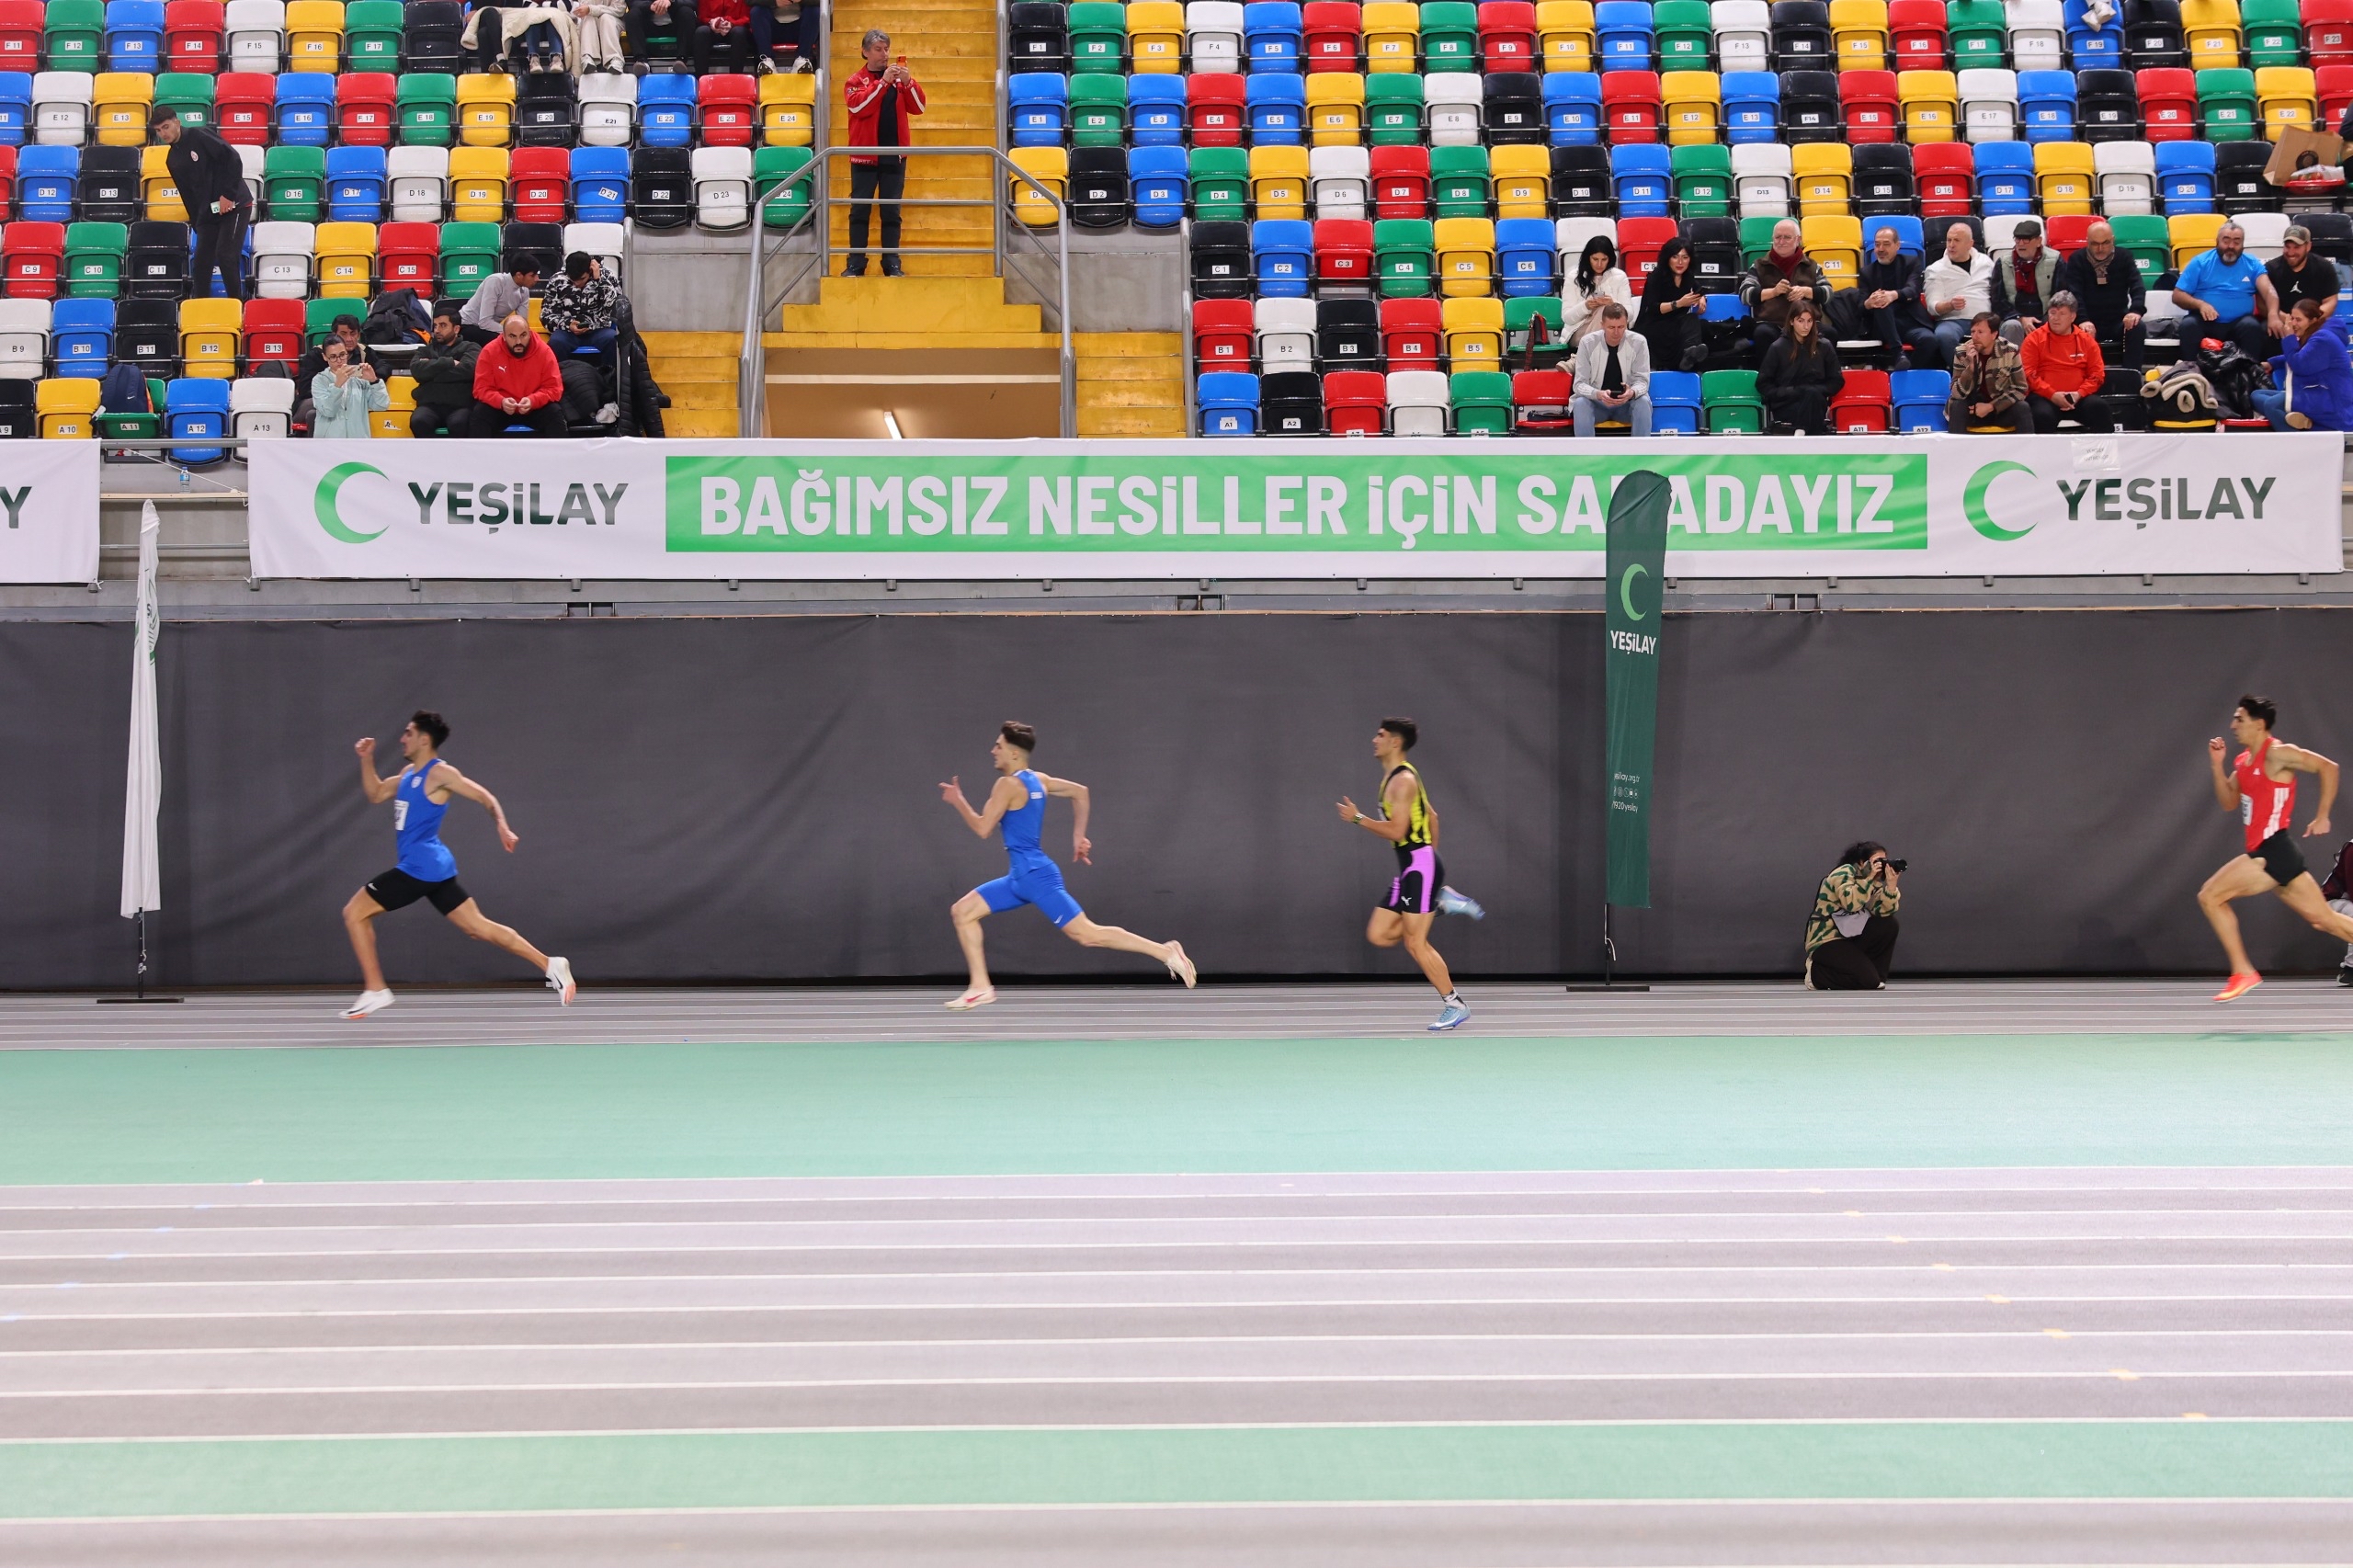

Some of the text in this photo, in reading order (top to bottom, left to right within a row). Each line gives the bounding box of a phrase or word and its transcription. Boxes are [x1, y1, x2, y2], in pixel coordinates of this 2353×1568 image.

[701, 468, 1008, 535] BAĞIMSIZ
[1029, 475, 1347, 535] NESİLLER
[1518, 475, 1893, 534] SAADAYIZ
